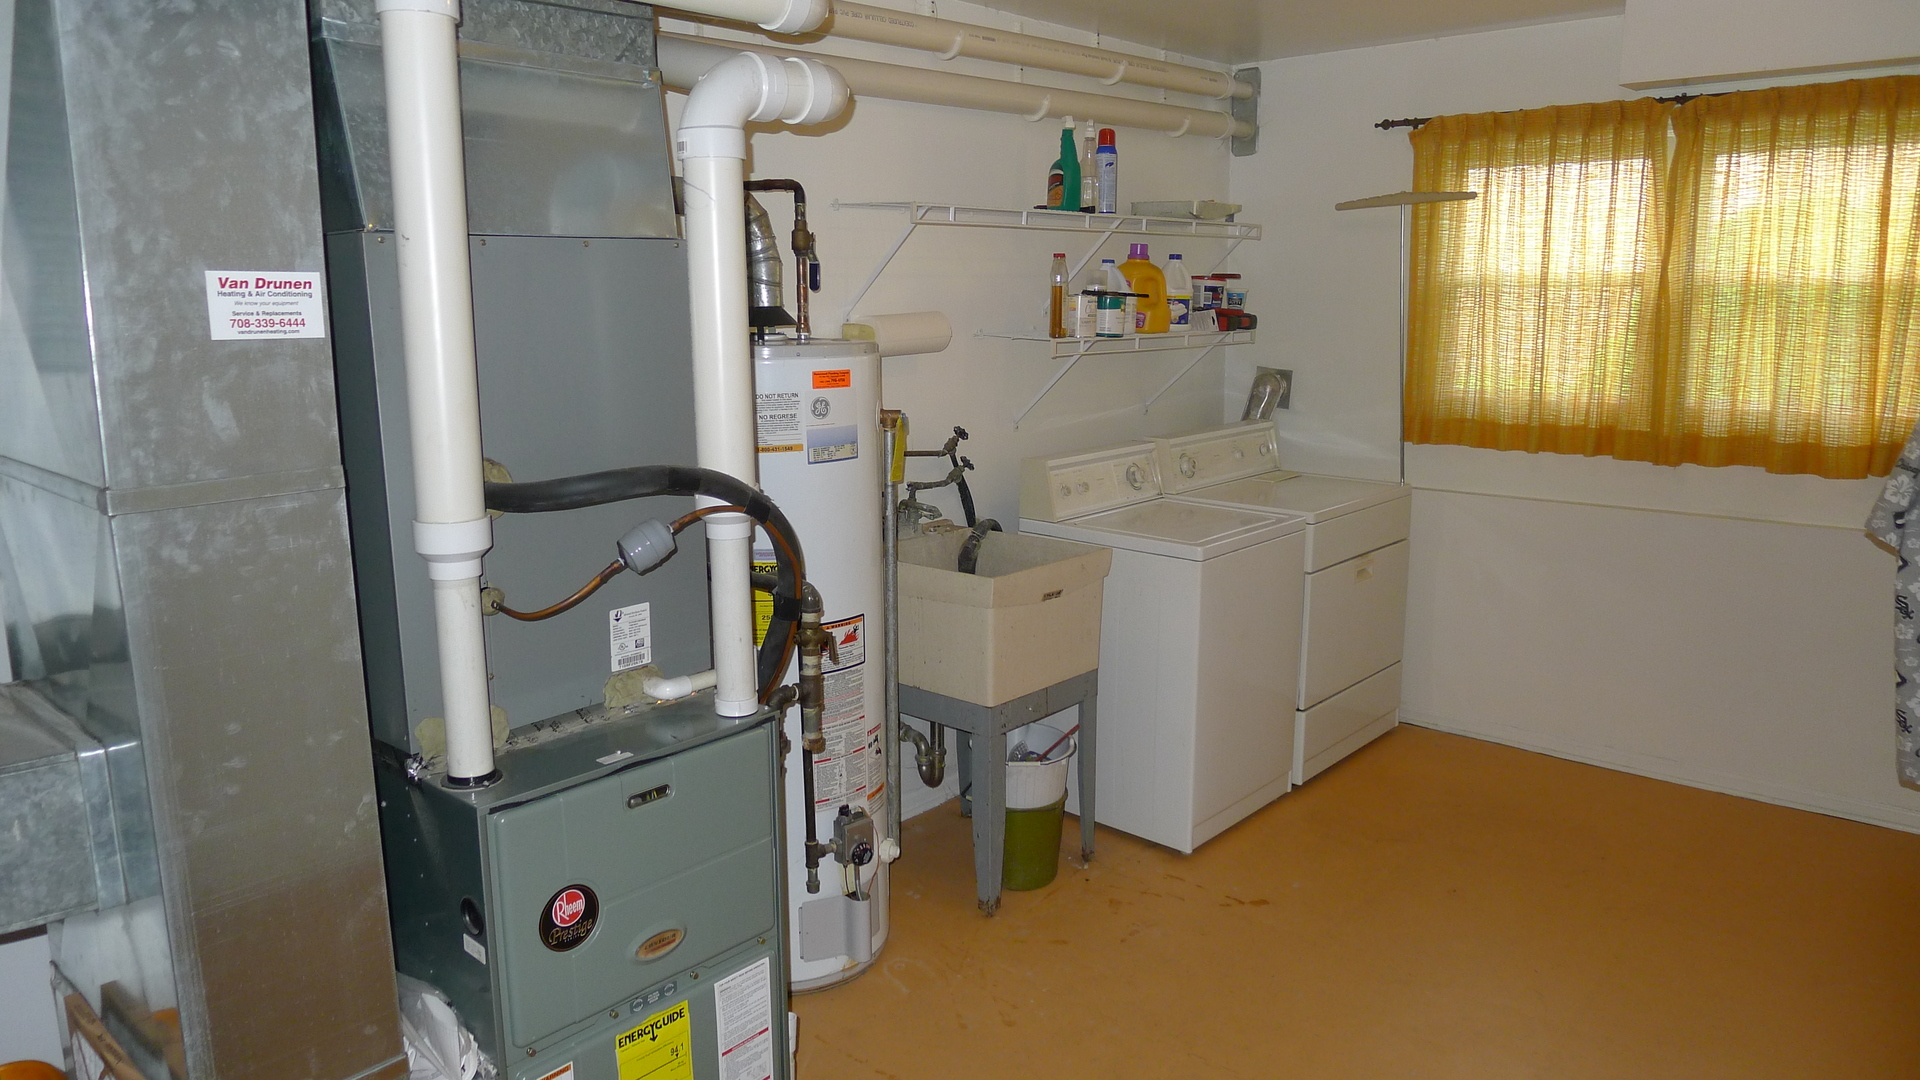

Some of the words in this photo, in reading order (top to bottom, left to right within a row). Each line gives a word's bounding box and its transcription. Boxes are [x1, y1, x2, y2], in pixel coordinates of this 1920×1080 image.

[217, 277, 249, 289] Van
[254, 277, 312, 290] Drunen
[217, 290, 246, 298] Heating
[267, 291, 313, 299] Conditioning
[229, 318, 306, 328] 708-339-6444
[556, 893, 583, 922] Rheem
[549, 918, 593, 945] Prestige
[618, 1007, 686, 1049] ENERGYGUIDE
